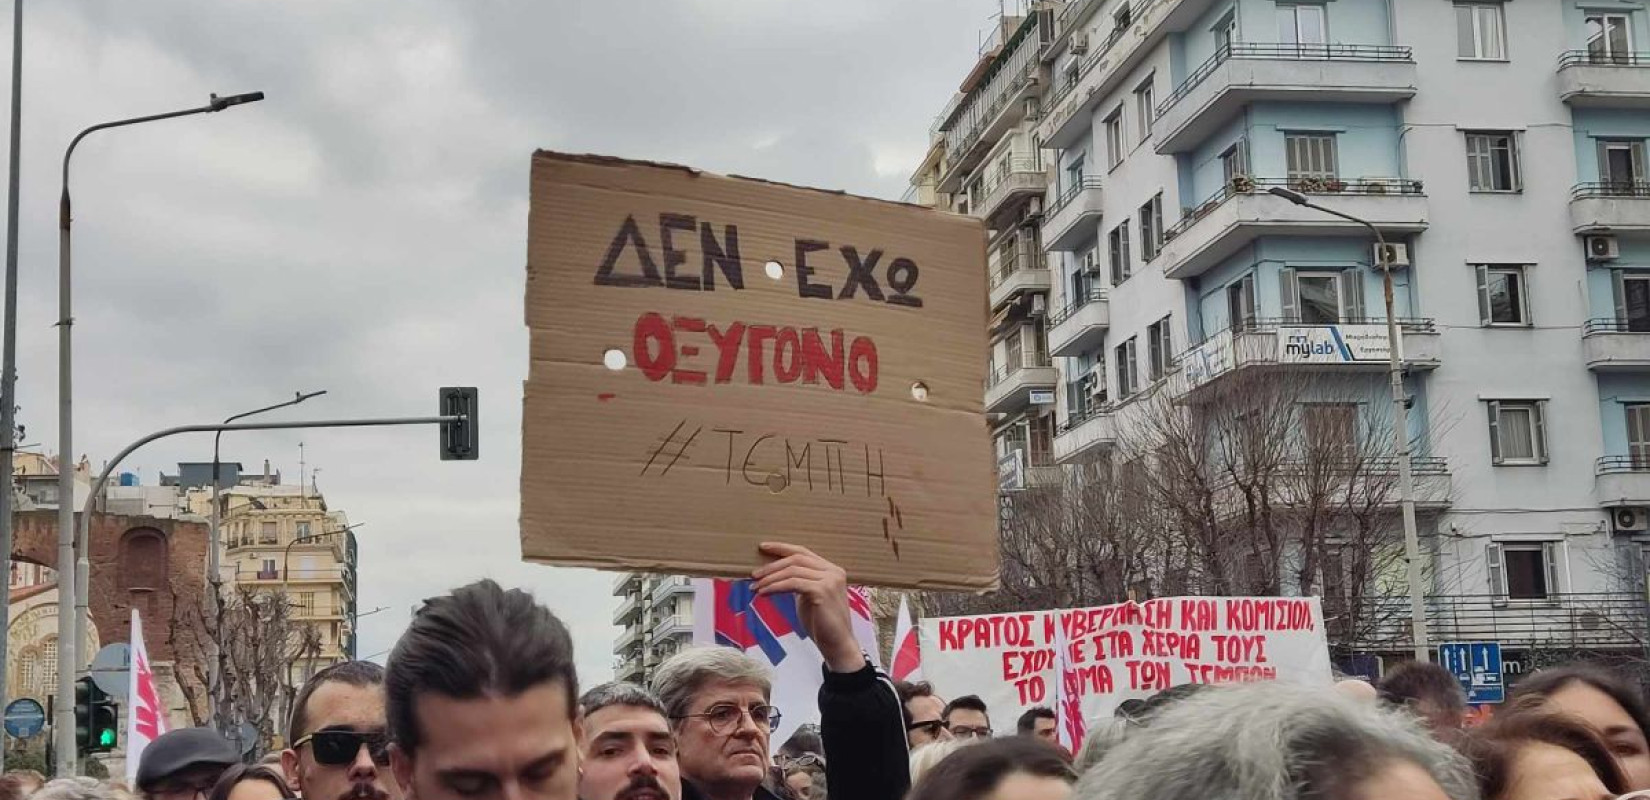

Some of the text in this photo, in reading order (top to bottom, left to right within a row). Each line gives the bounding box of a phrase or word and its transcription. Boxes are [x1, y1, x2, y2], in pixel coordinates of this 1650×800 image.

[593, 212, 924, 308] ΔΕΝ ΕΧΩ
[633, 311, 879, 394] ΟΞΥΓΟΝΟ
[1286, 340, 1334, 358] mylab
[640, 419, 886, 497] #ΤΕΜΠΗ
[938, 614, 1035, 651] ΚΡΑΤΟΣ
[1181, 599, 1218, 632] ΚΑΙ
[1092, 630, 1134, 661] ΣΤΑ
[1142, 629, 1200, 660] ΧΕΡΙΑ
[1210, 635, 1267, 664] ΤΟΥΣ
[1014, 675, 1046, 706] ΤΟ
[1125, 660, 1171, 690] ΤΩΝ
